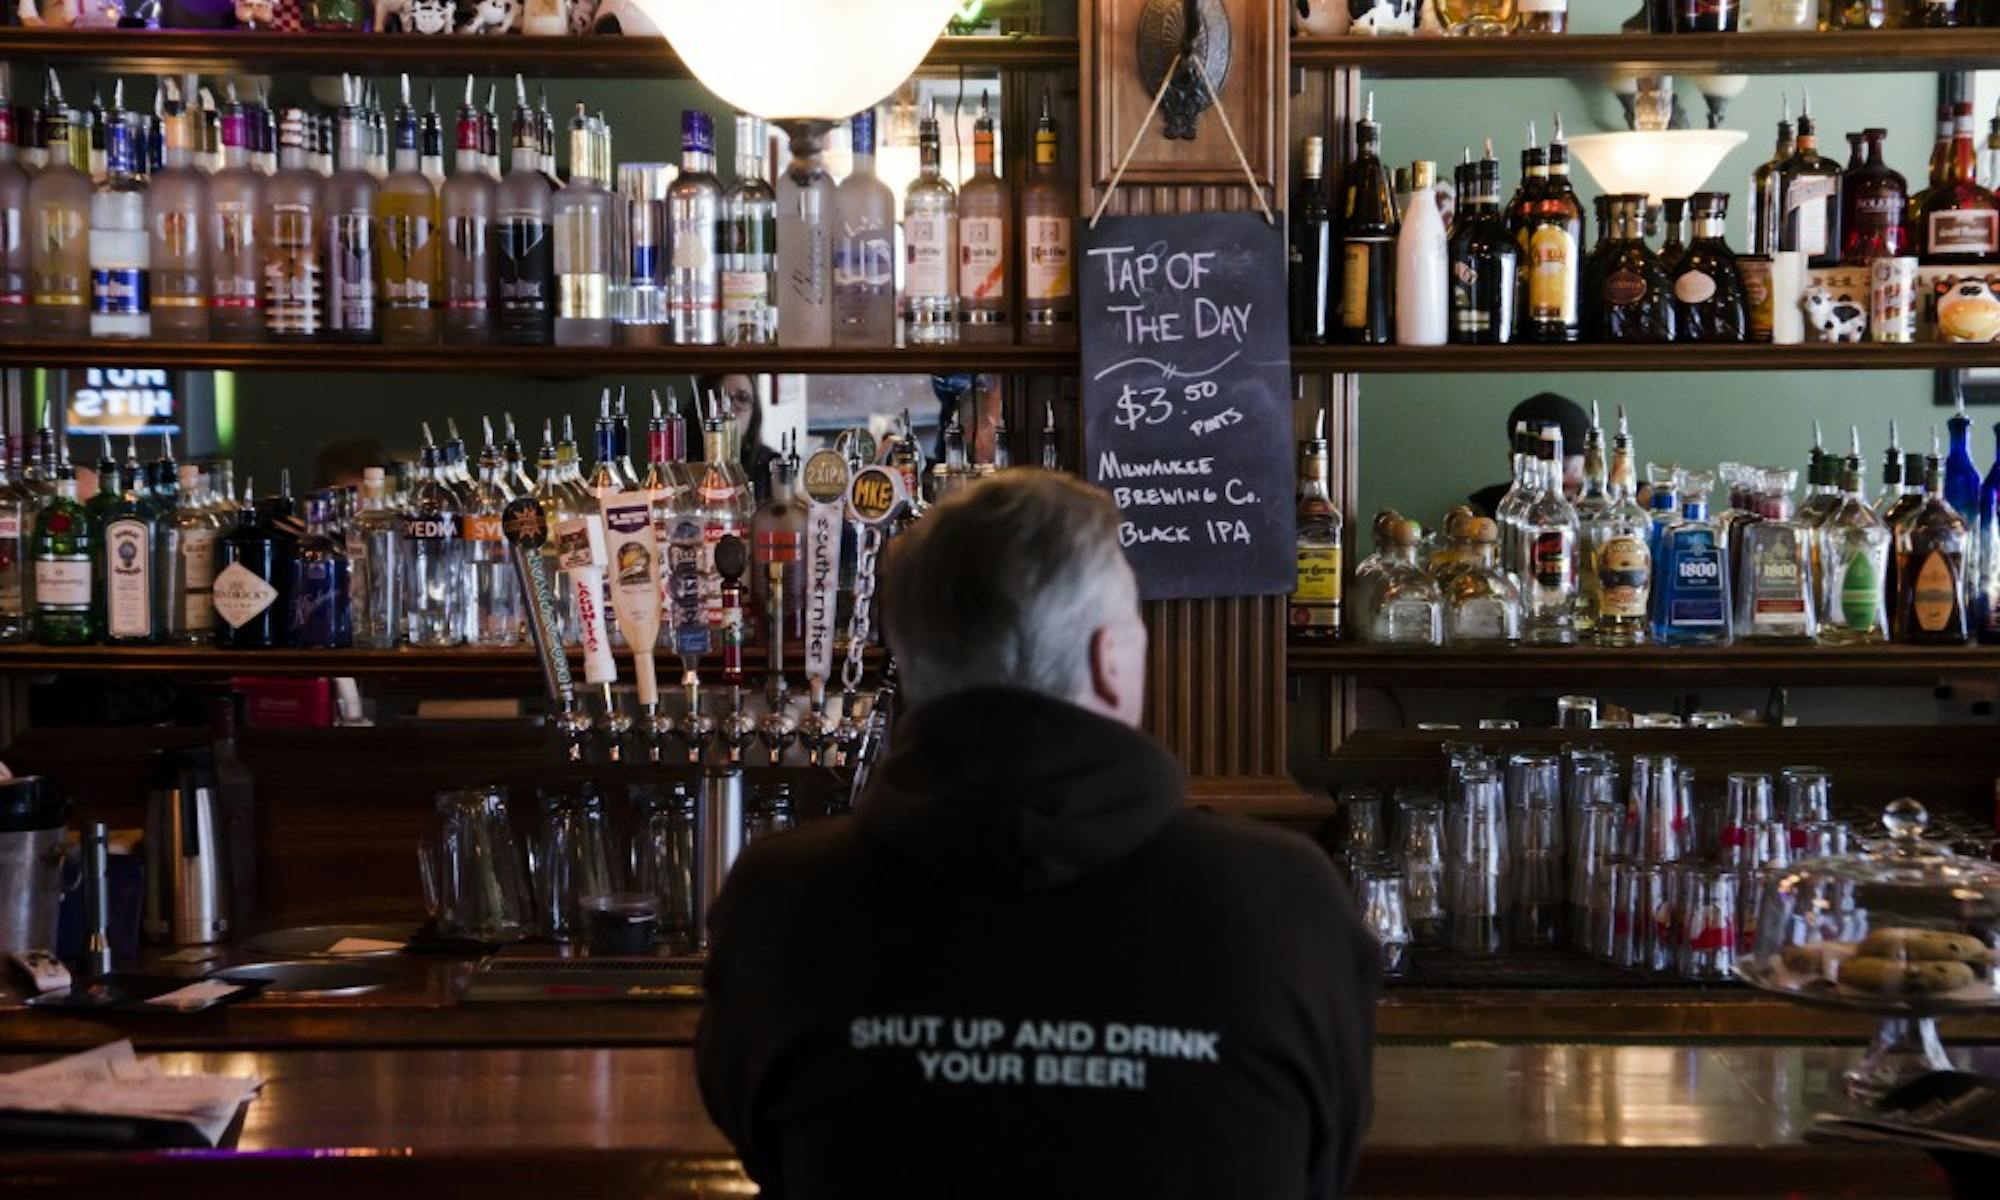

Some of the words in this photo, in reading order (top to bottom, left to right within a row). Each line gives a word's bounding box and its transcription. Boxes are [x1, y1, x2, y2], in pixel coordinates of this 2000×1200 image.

[1087, 246, 1158, 297] TAP
[1164, 252, 1216, 290] OF
[1107, 304, 1184, 345] THE
[1195, 297, 1252, 343] DAY
[1189, 407, 1244, 437] PINTS
[1098, 451, 1215, 481] MILWAUKEE
[854, 479, 891, 509] MKE
[1113, 487, 1217, 509] BREWING
[1118, 521, 1191, 548] BLACK
[1207, 519, 1251, 546] IPA
[1680, 562, 1717, 578] 1800
[850, 1016, 943, 1049] SHUT
[953, 1018, 1006, 1049] UP
[1015, 1021, 1095, 1051] AND
[1105, 1024, 1220, 1061] DRINK
[918, 1051, 1024, 1082] YOUR
[1035, 1055, 1146, 1089] BEER!
